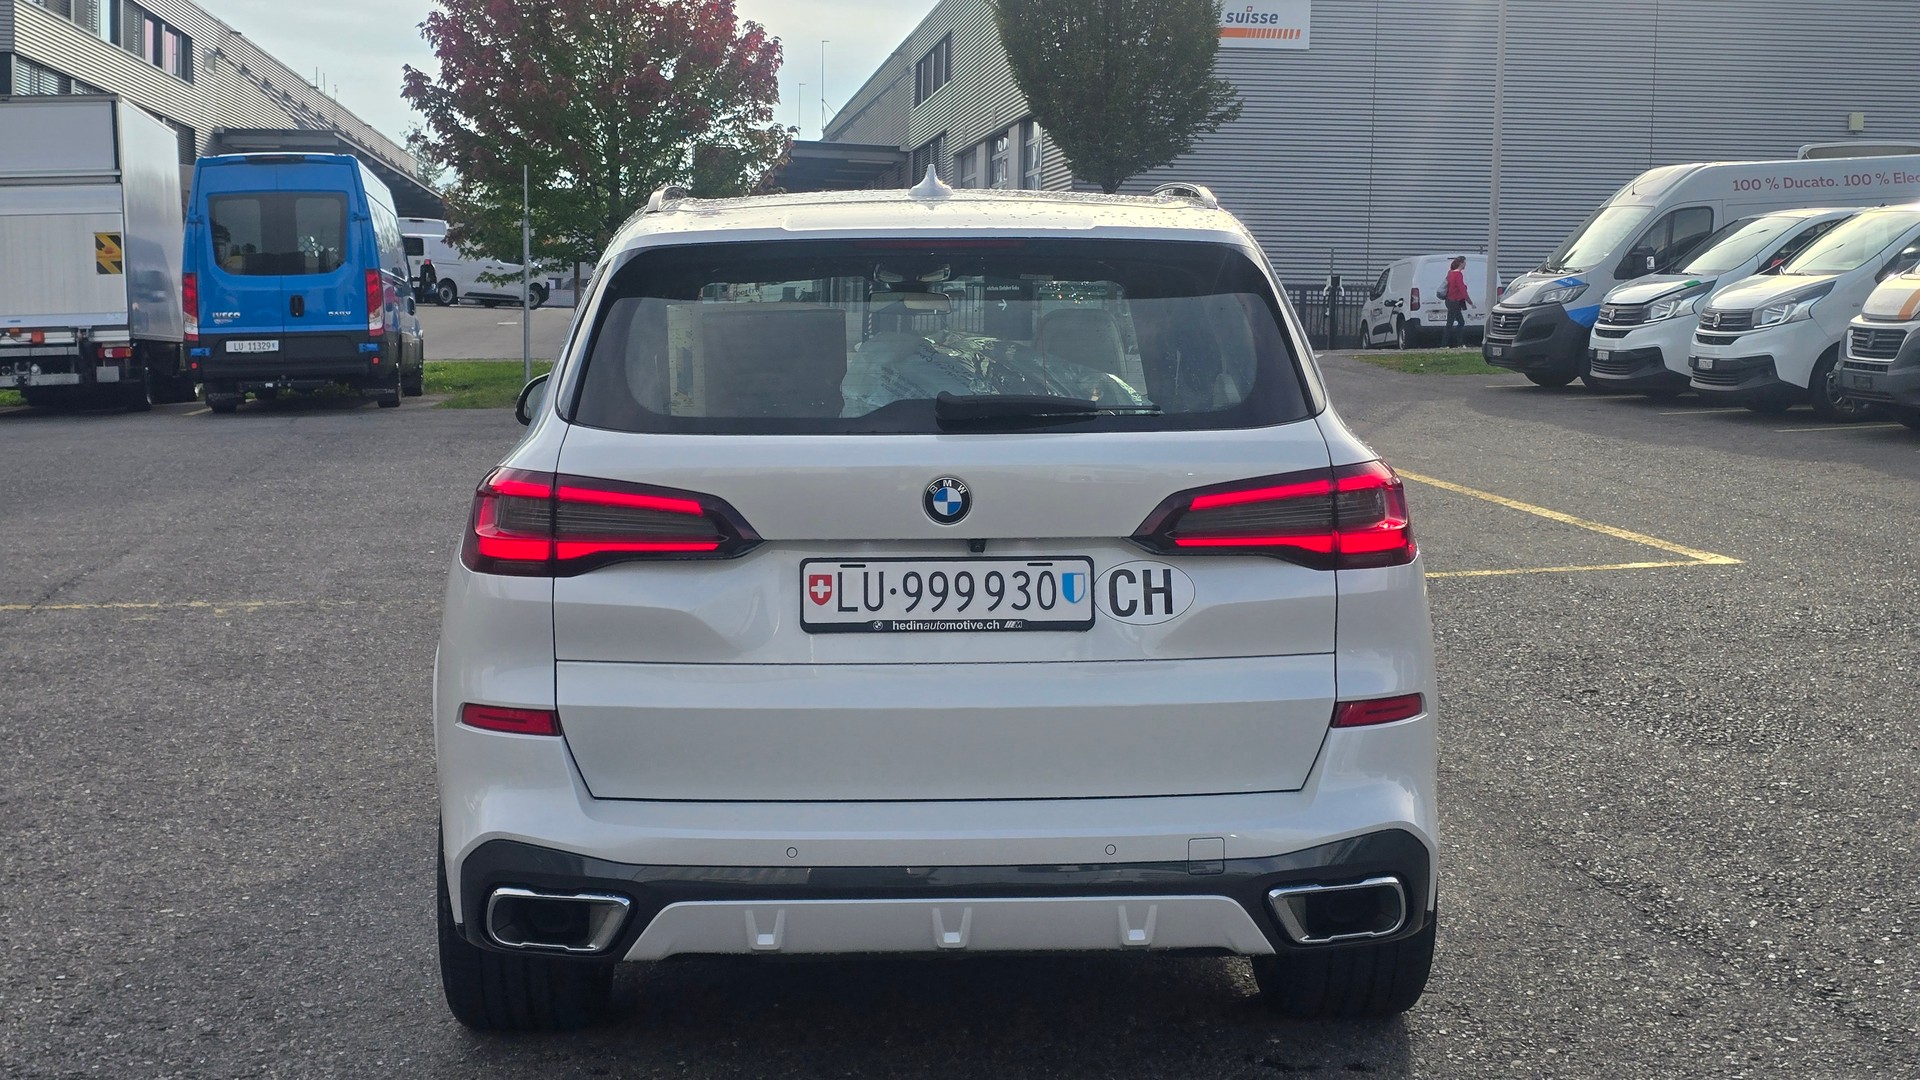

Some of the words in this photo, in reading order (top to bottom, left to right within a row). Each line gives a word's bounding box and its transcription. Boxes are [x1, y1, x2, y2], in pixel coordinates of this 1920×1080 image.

[1225, 6, 1278, 24] suisse
[1732, 179, 1762, 192] 100
[1765, 177, 1780, 191] %
[1783, 176, 1839, 189] Ducato.
[1843, 174, 1872, 187] 100
[1875, 172, 1890, 185] %
[929, 480, 967, 494] BMW
[1109, 568, 1174, 617] CH
[892, 620, 1000, 631] hedinautomotive.ch
